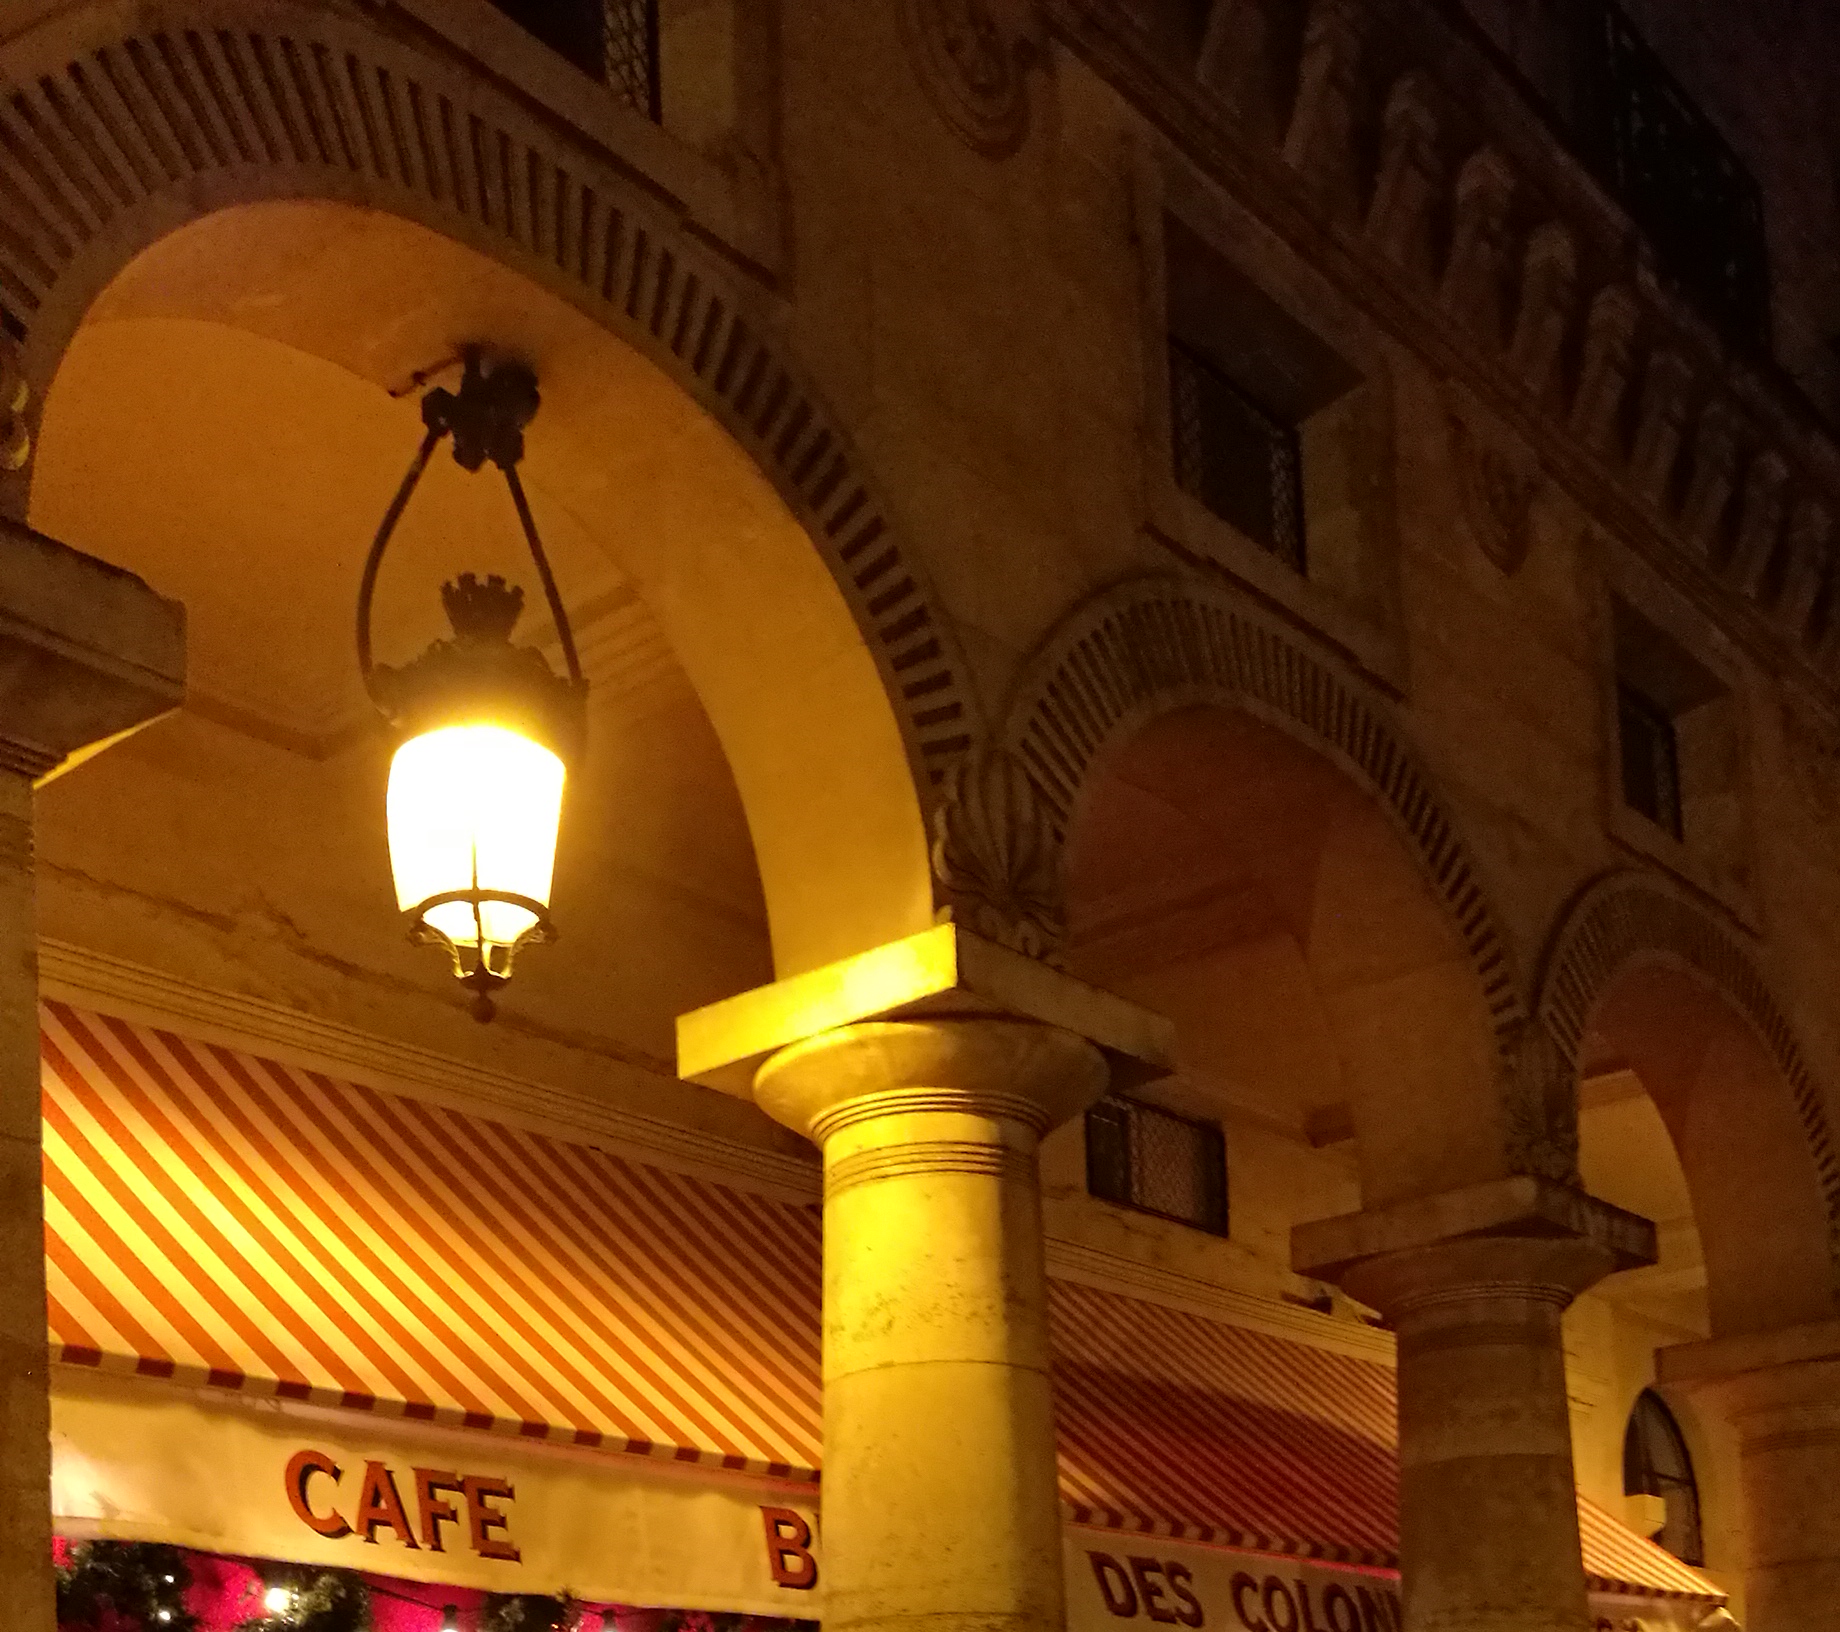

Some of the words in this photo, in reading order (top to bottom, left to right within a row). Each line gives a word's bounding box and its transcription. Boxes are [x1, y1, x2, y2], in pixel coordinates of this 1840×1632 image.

[285, 1450, 521, 1564] CAFE
[757, 1506, 821, 1590] B
[1087, 1551, 1203, 1628] DES
